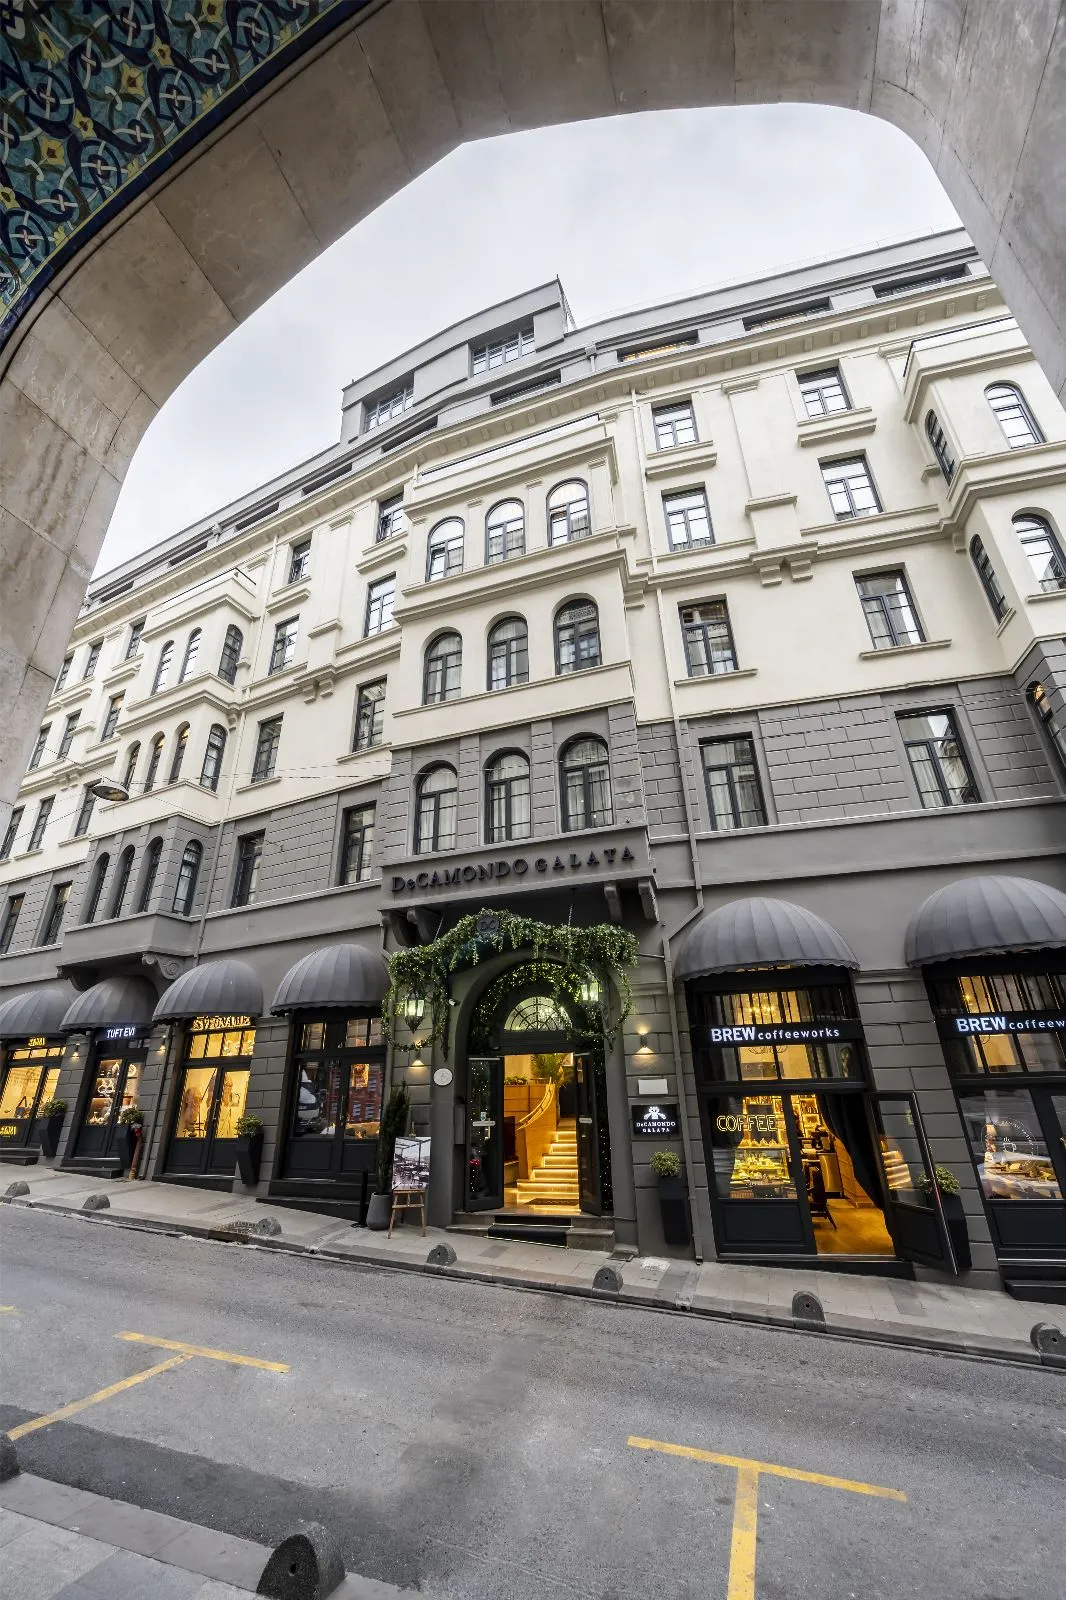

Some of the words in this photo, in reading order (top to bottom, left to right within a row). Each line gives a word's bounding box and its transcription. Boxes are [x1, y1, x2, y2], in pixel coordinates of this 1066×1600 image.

[391, 858, 528, 892] DeCAMONDO
[535, 846, 634, 872] GALATA
[956, 1016, 1006, 1032] BREW
[106, 1028, 124, 1038] TUFT
[711, 1027, 756, 1042] BREW
[758, 1028, 840, 1040] coffeeworks
[716, 1115, 777, 1131] COFFEE
